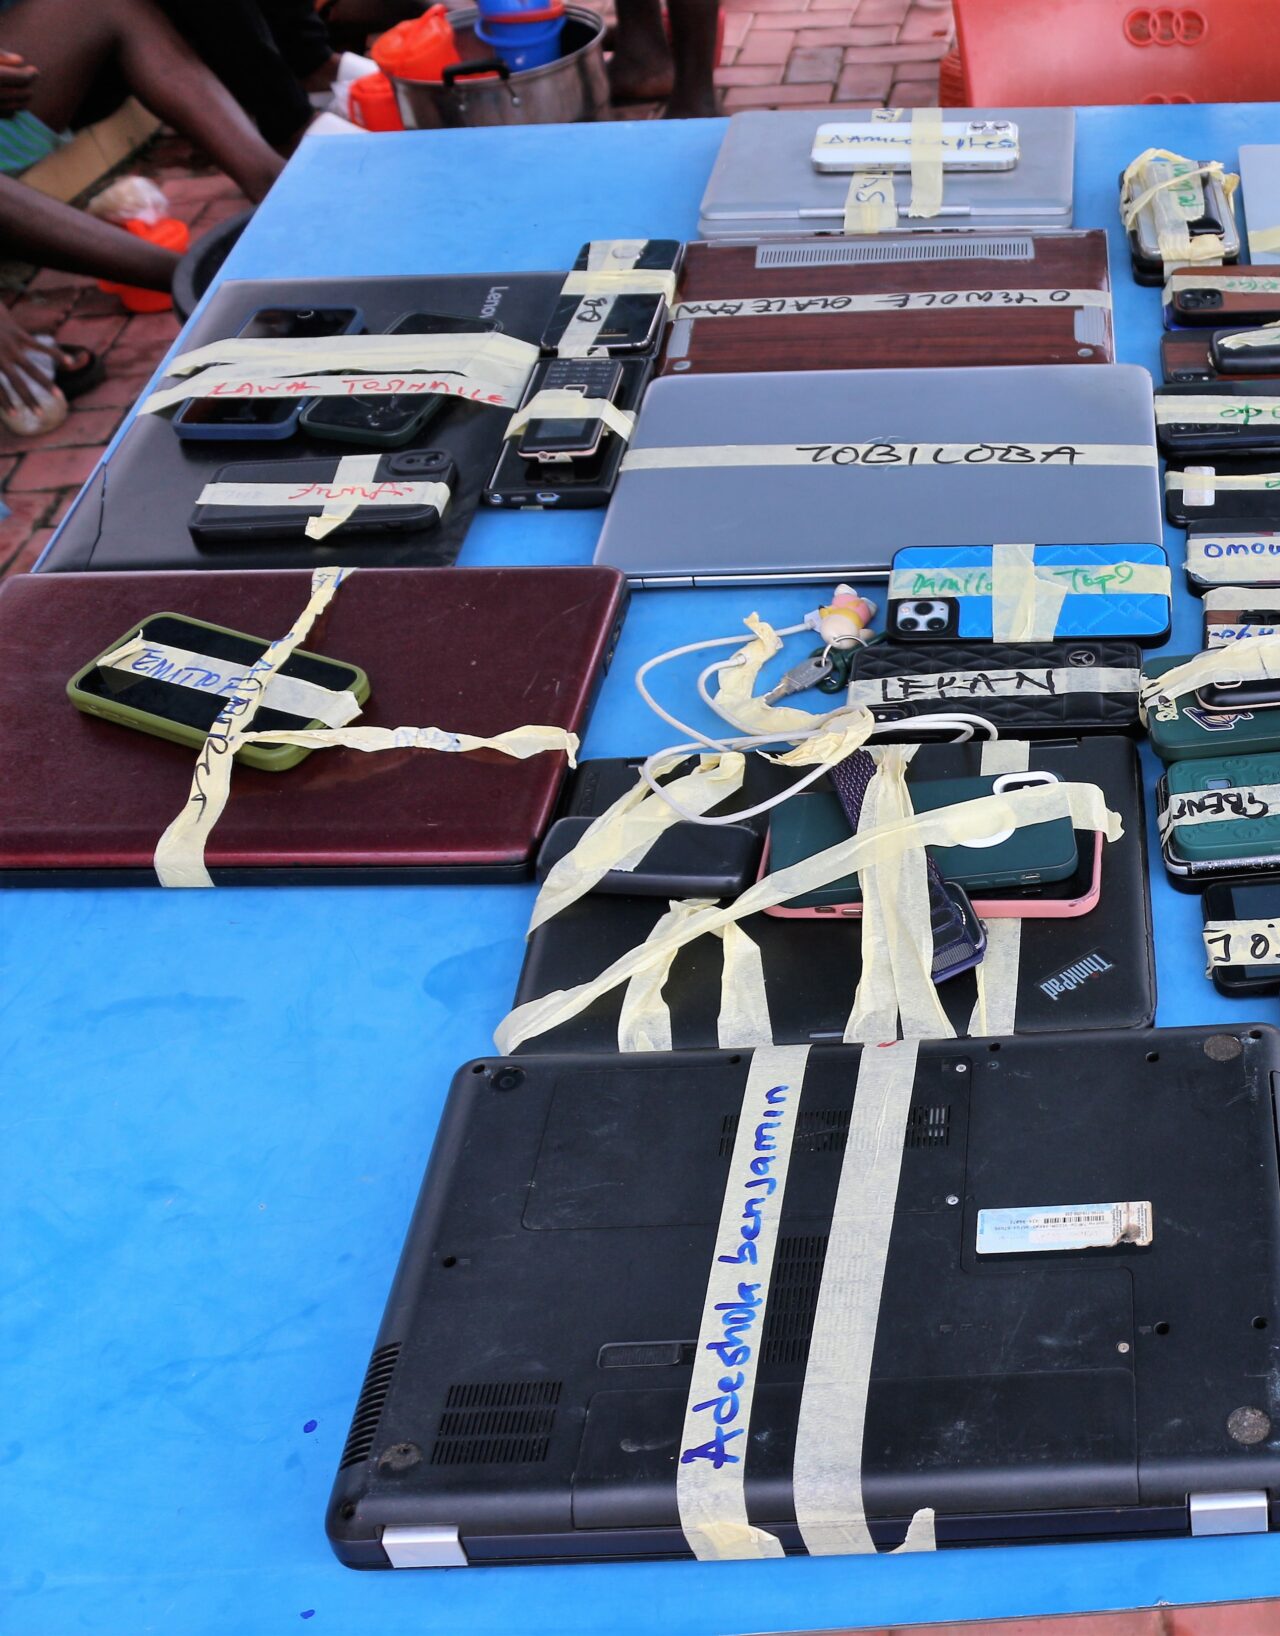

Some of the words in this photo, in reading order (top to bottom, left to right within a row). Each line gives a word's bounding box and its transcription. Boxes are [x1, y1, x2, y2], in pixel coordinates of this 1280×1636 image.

[478, 285, 510, 320] Leno
[796, 443, 1085, 466] TOBILOBA
[881, 669, 1057, 702] LEKAN
[1038, 950, 1114, 1003] ThinkPad
